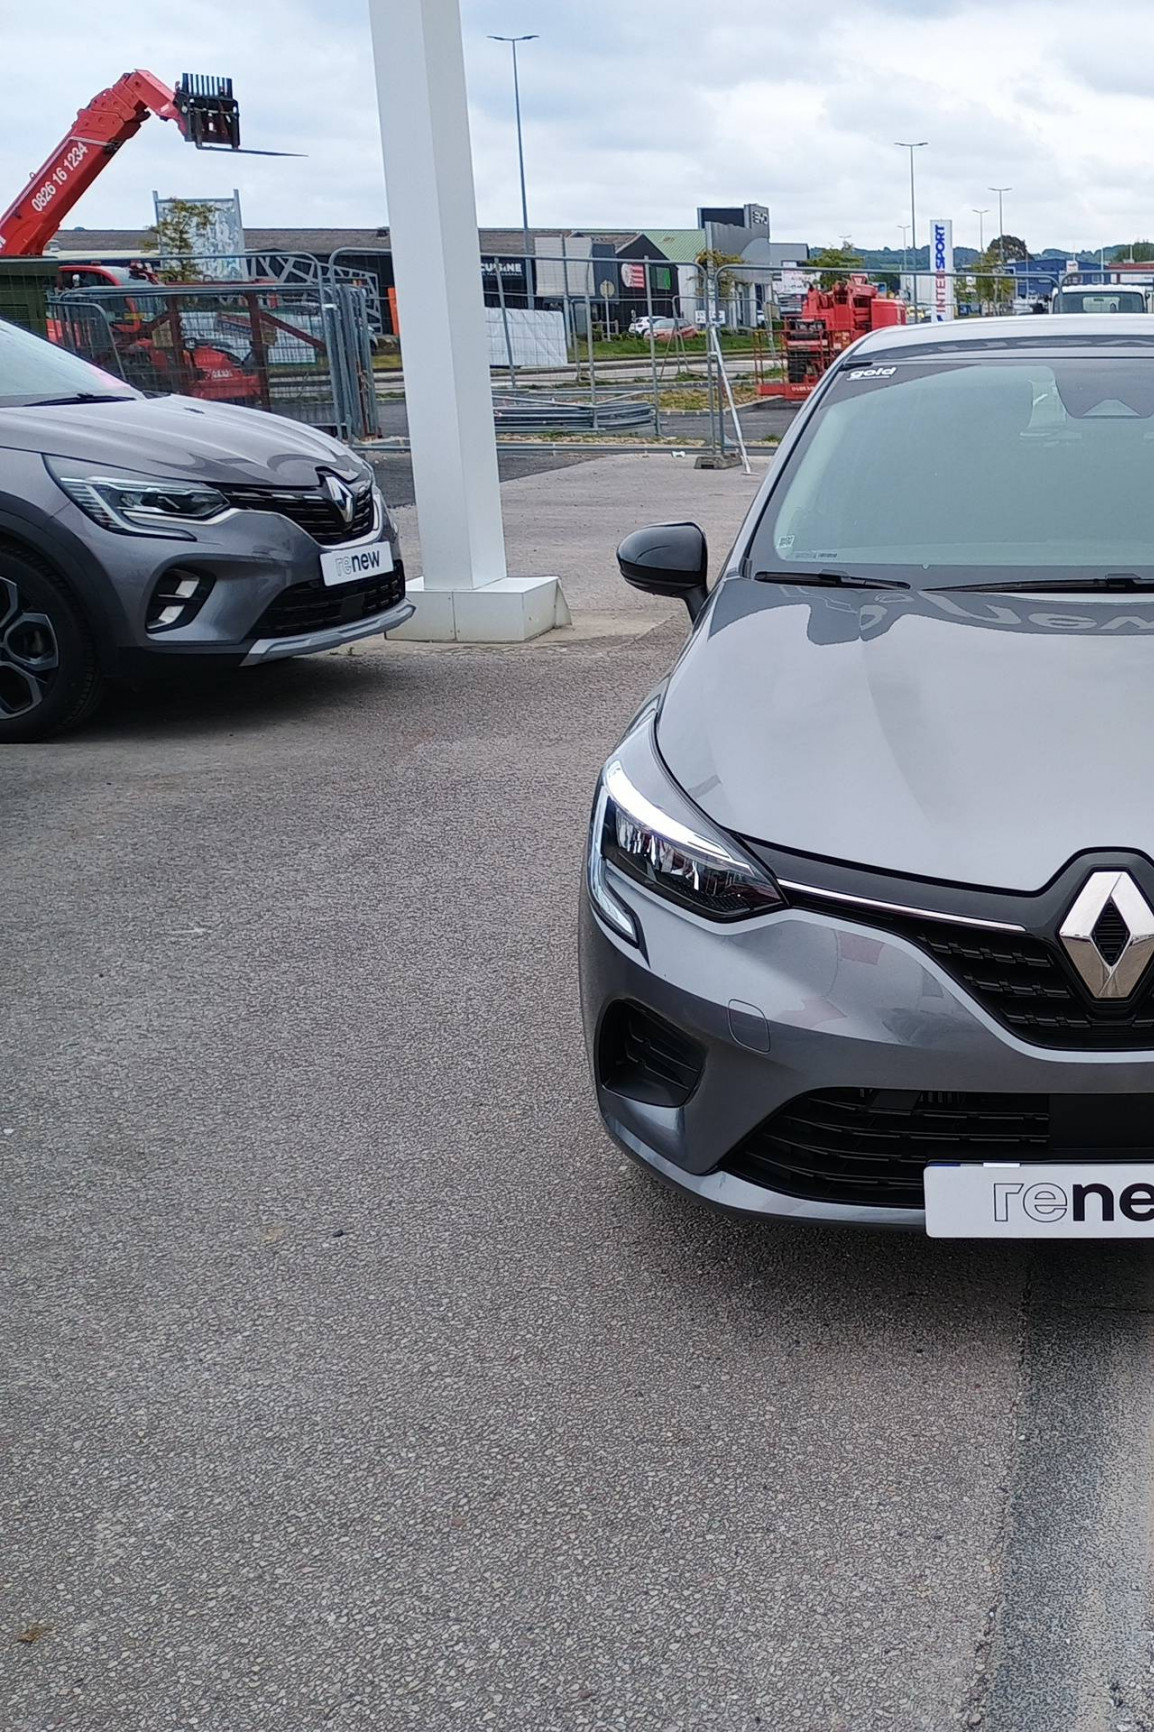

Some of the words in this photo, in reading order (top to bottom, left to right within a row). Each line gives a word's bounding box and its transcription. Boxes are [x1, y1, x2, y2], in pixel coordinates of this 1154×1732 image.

[31, 181, 56, 212] 0826
[52, 167, 68, 185] 16
[63, 141, 88, 171] 1234
[848, 367, 897, 380] gold
[334, 550, 380, 577] renew
